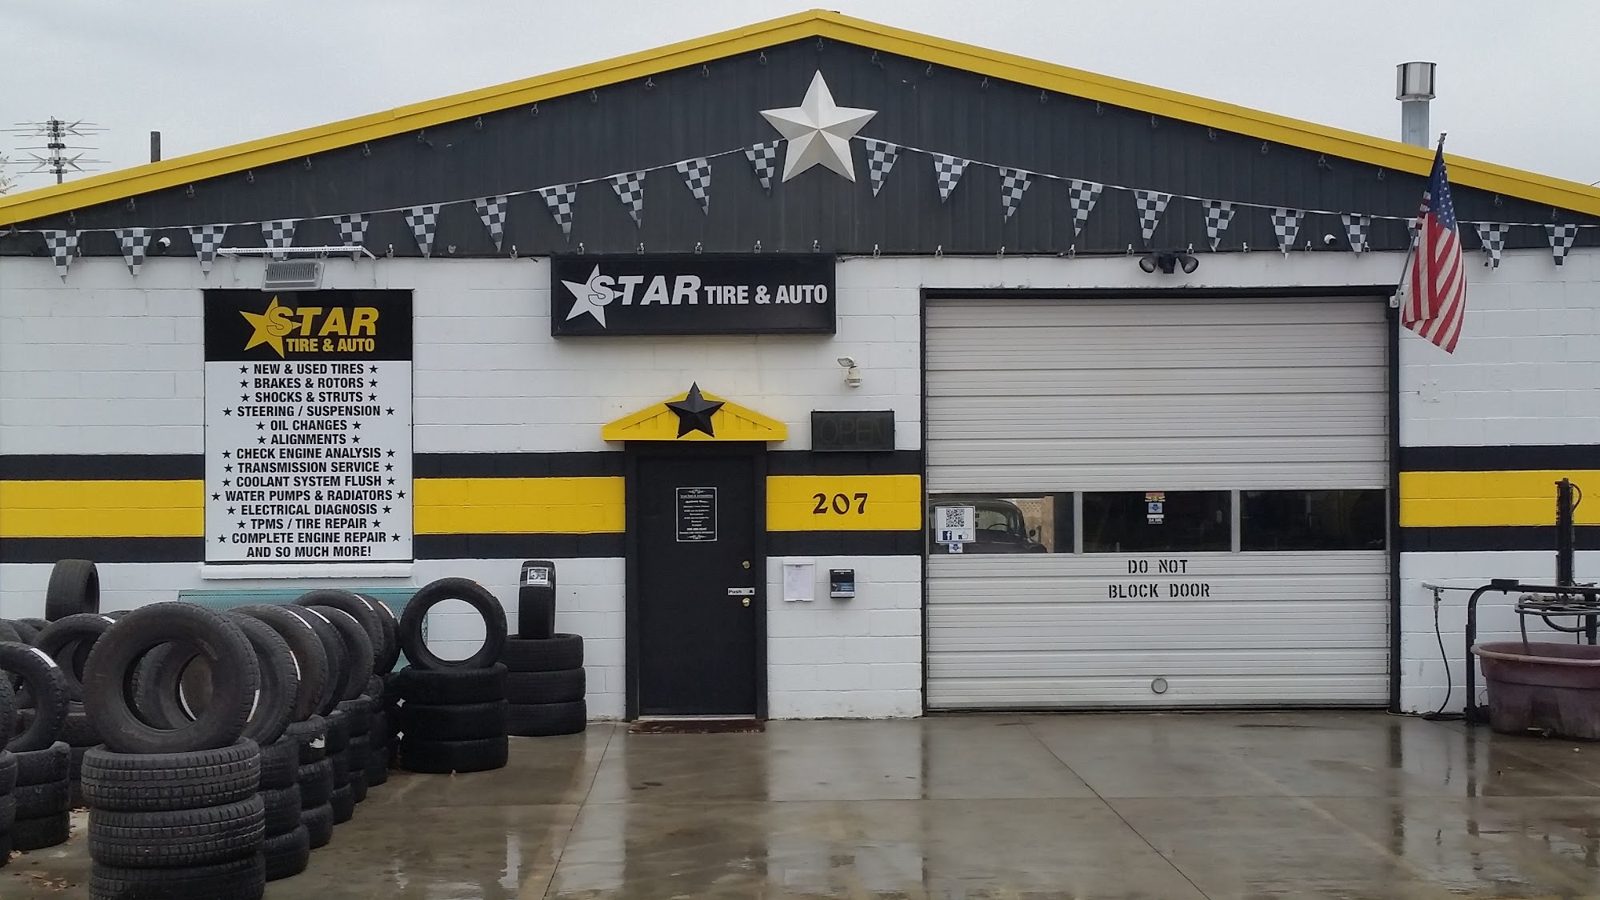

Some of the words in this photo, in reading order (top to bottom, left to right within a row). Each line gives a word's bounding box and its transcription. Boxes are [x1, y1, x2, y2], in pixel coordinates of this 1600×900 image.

[588, 274, 701, 307] STAR
[704, 286, 749, 305] TIRE
[754, 285, 771, 304] &
[776, 284, 827, 304] AUTO
[266, 306, 379, 337] STAR
[286, 338, 318, 352] TIRE
[322, 338, 334, 352] &
[337, 338, 375, 352] AUTO
[254, 364, 280, 374] NEW
[284, 364, 293, 374] &
[297, 364, 327, 374] USED
[331, 363, 364, 374] TIRES
[254, 378, 301, 388] BRAKES
[305, 378, 314, 388] &
[318, 377, 364, 388] ROTORS
[255, 392, 302, 403] SHOCKS
[306, 391, 315, 402] &
[318, 391, 363, 402] STRUTS
[237, 406, 294, 417] STEERING
[306, 405, 381, 416] SUSPENSION
[270, 420, 288, 431] OIL
[292, 420, 347, 431] CHANGES
[820, 418, 887, 444] OPEN
[271, 434, 346, 445] ALIGNMENTS
[236, 448, 275, 459] CHECK
[279, 448, 322, 459] ENGINE
[325, 447, 381, 458] ANALYSIS
[238, 462, 327, 473] TRANSMISSION
[331, 461, 379, 472] SERVICE
[236, 476, 290, 487] COOLANT
[293, 476, 340, 487] SYSTEM
[345, 475, 381, 486] FLUSH
[225, 491, 265, 501] WATER
[269, 490, 310, 501] PUMPS
[314, 490, 323, 501] &
[327, 490, 393, 501] RADIATORS
[241, 504, 310, 515] ELECTRICAL
[315, 504, 378, 515] DIAGNOSIS
[812, 493, 868, 515] 207
[251, 518, 284, 529] TPMS
[296, 518, 321, 529] TIRE
[325, 518, 367, 528] REPAIR
[232, 532, 294, 544] COMPLETE
[298, 532, 340, 543] ENGINE
[344, 532, 386, 543] REPAIR
[246, 546, 271, 557] AND
[275, 546, 291, 557] SO
[295, 546, 328, 557] MUCH
[333, 546, 371, 557] MORE!
[1128, 559, 1149, 574] DO
[1158, 559, 1188, 574] NOT
[1108, 583, 1159, 599] BLOCK
[1169, 583, 1210, 598] DOOR
